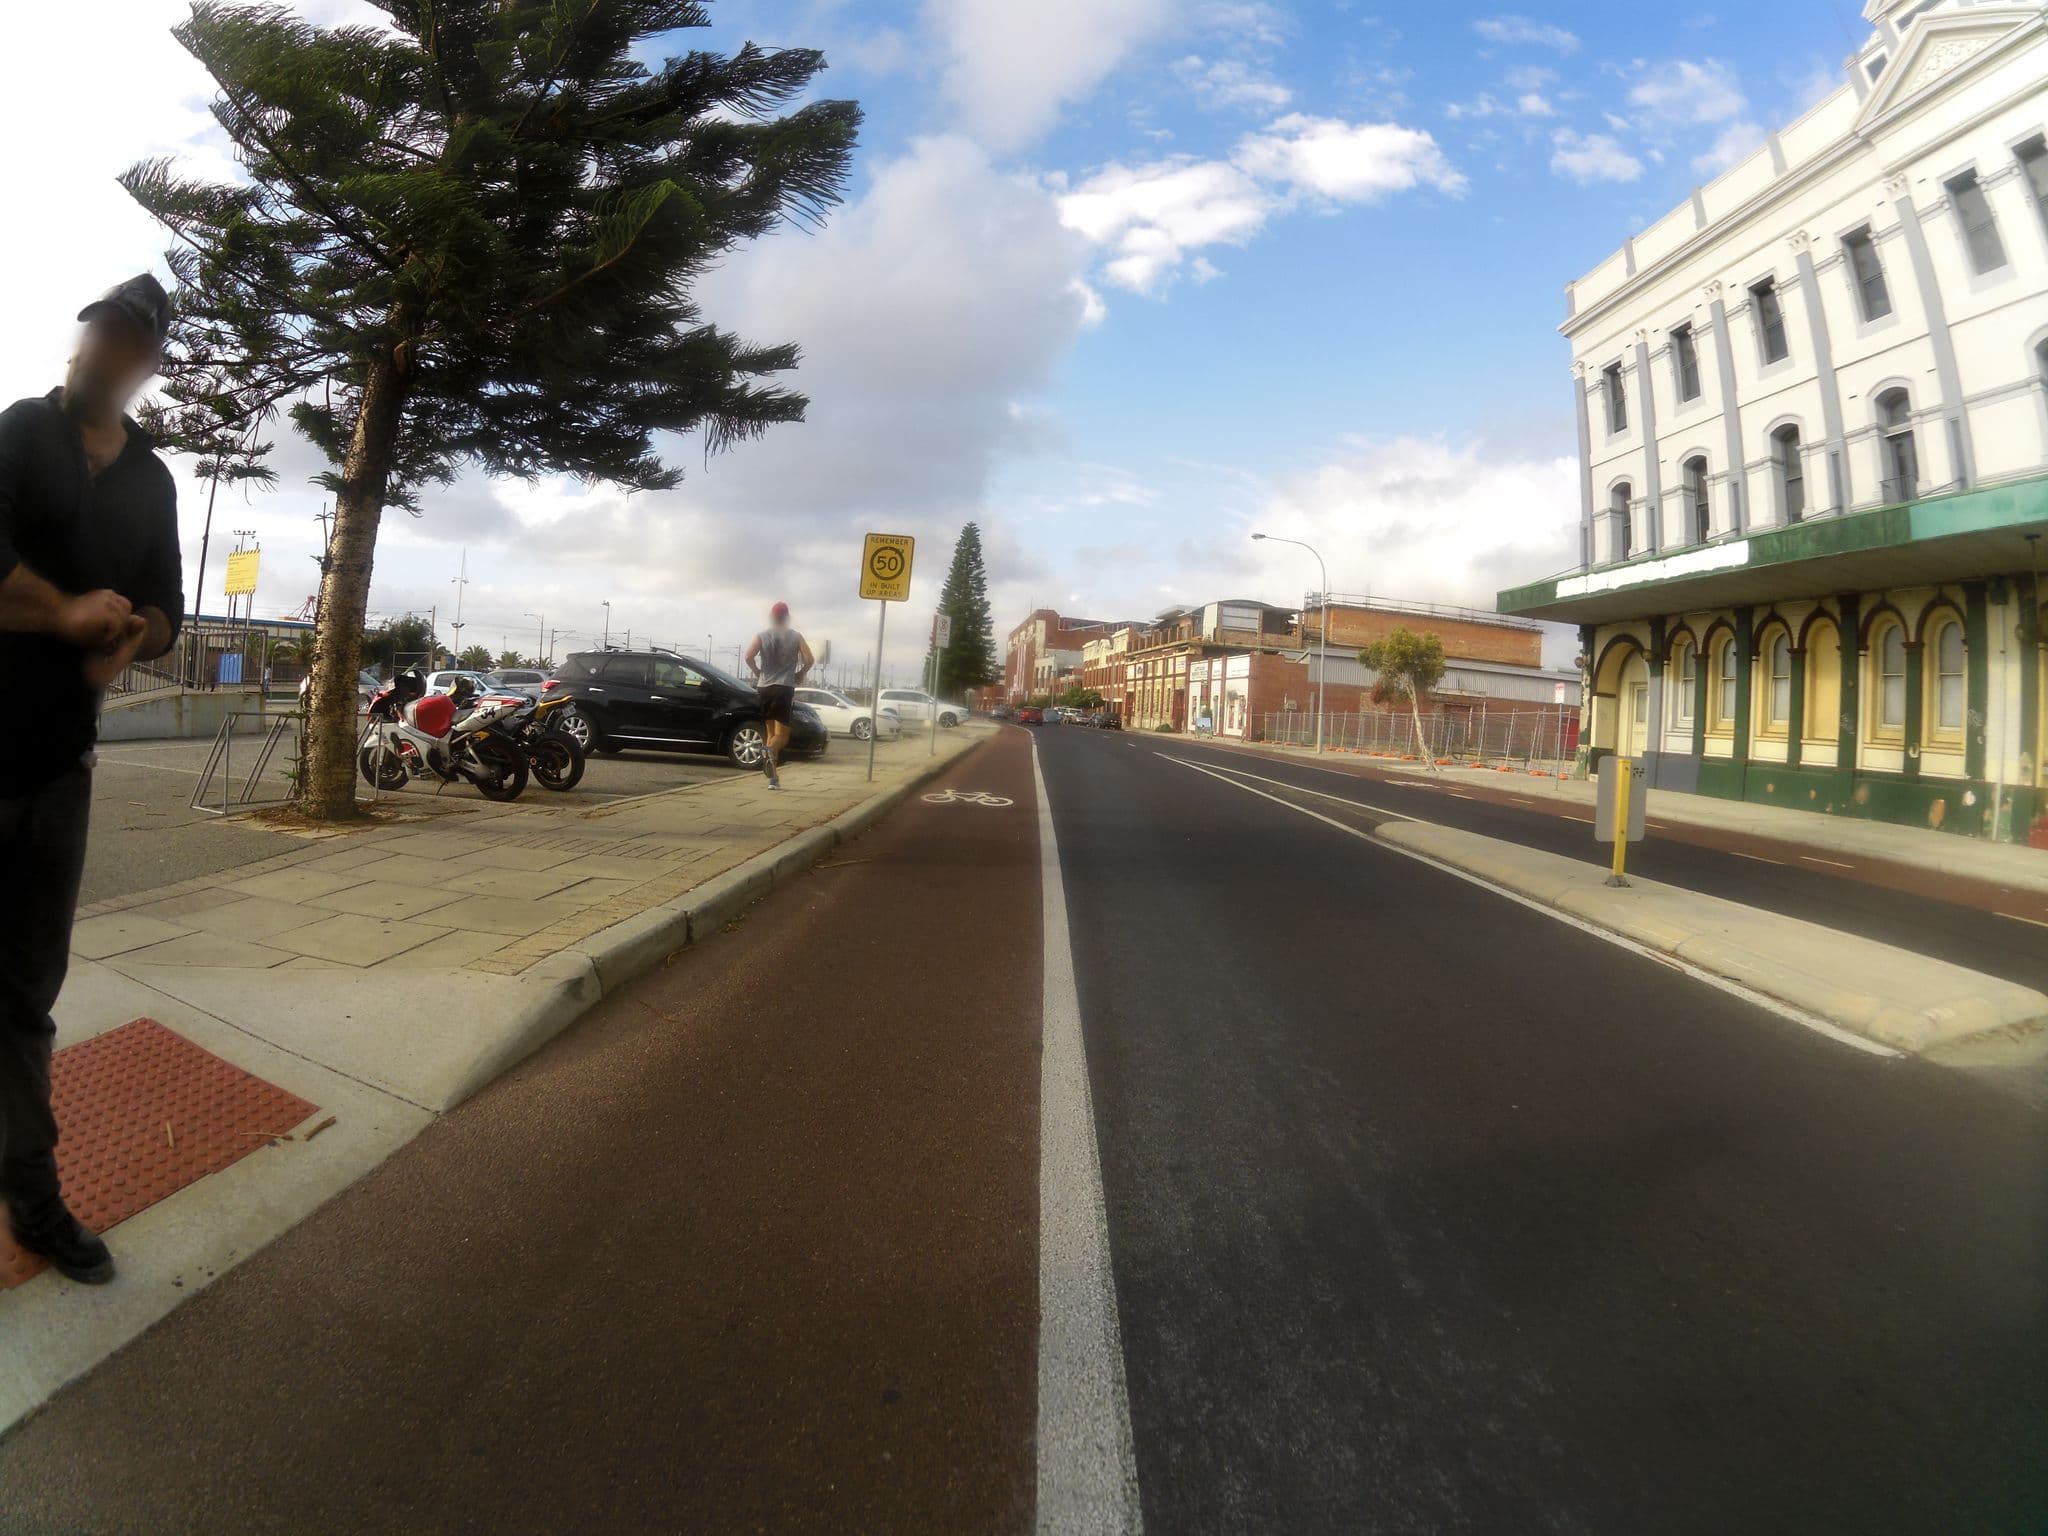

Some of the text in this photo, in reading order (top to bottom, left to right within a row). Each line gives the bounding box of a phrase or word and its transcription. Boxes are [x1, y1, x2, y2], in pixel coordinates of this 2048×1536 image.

[870, 536, 909, 545] REMEMBER
[876, 556, 898, 571] 50
[880, 582, 901, 590] BUILT
[879, 590, 902, 598] AREAS
[480, 706, 496, 719] 34
